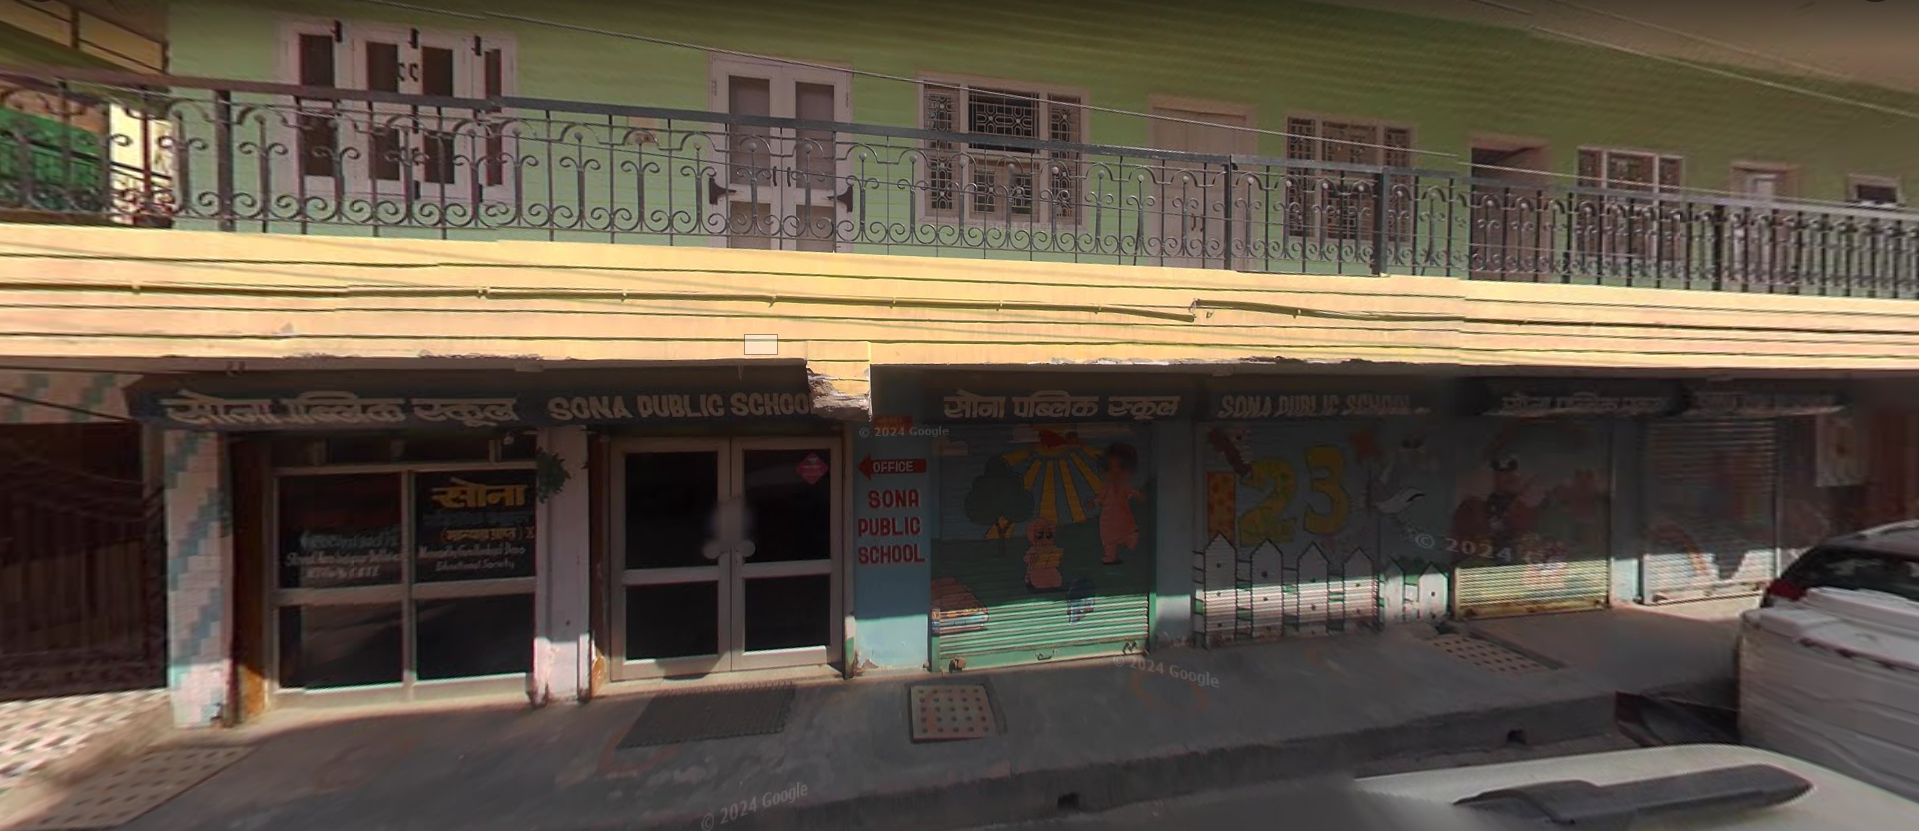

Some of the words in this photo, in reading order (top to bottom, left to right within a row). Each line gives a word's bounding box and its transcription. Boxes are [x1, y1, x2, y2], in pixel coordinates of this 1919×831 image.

[160, 389, 272, 422] सोना
[547, 395, 634, 421] SONA
[636, 392, 726, 419] PUBLIC
[943, 388, 1006, 419] सोना
[1012, 390, 1100, 420] पब्लिक
[1107, 395, 1181, 420] स्कूल
[1217, 394, 1273, 420] SONA
[872, 460, 914, 473] OFFICE
[431, 476, 528, 508] सोना
[867, 489, 921, 509] SONA
[858, 516, 921, 537] PUBLIC
[858, 543, 926, 565] SCHOOL
